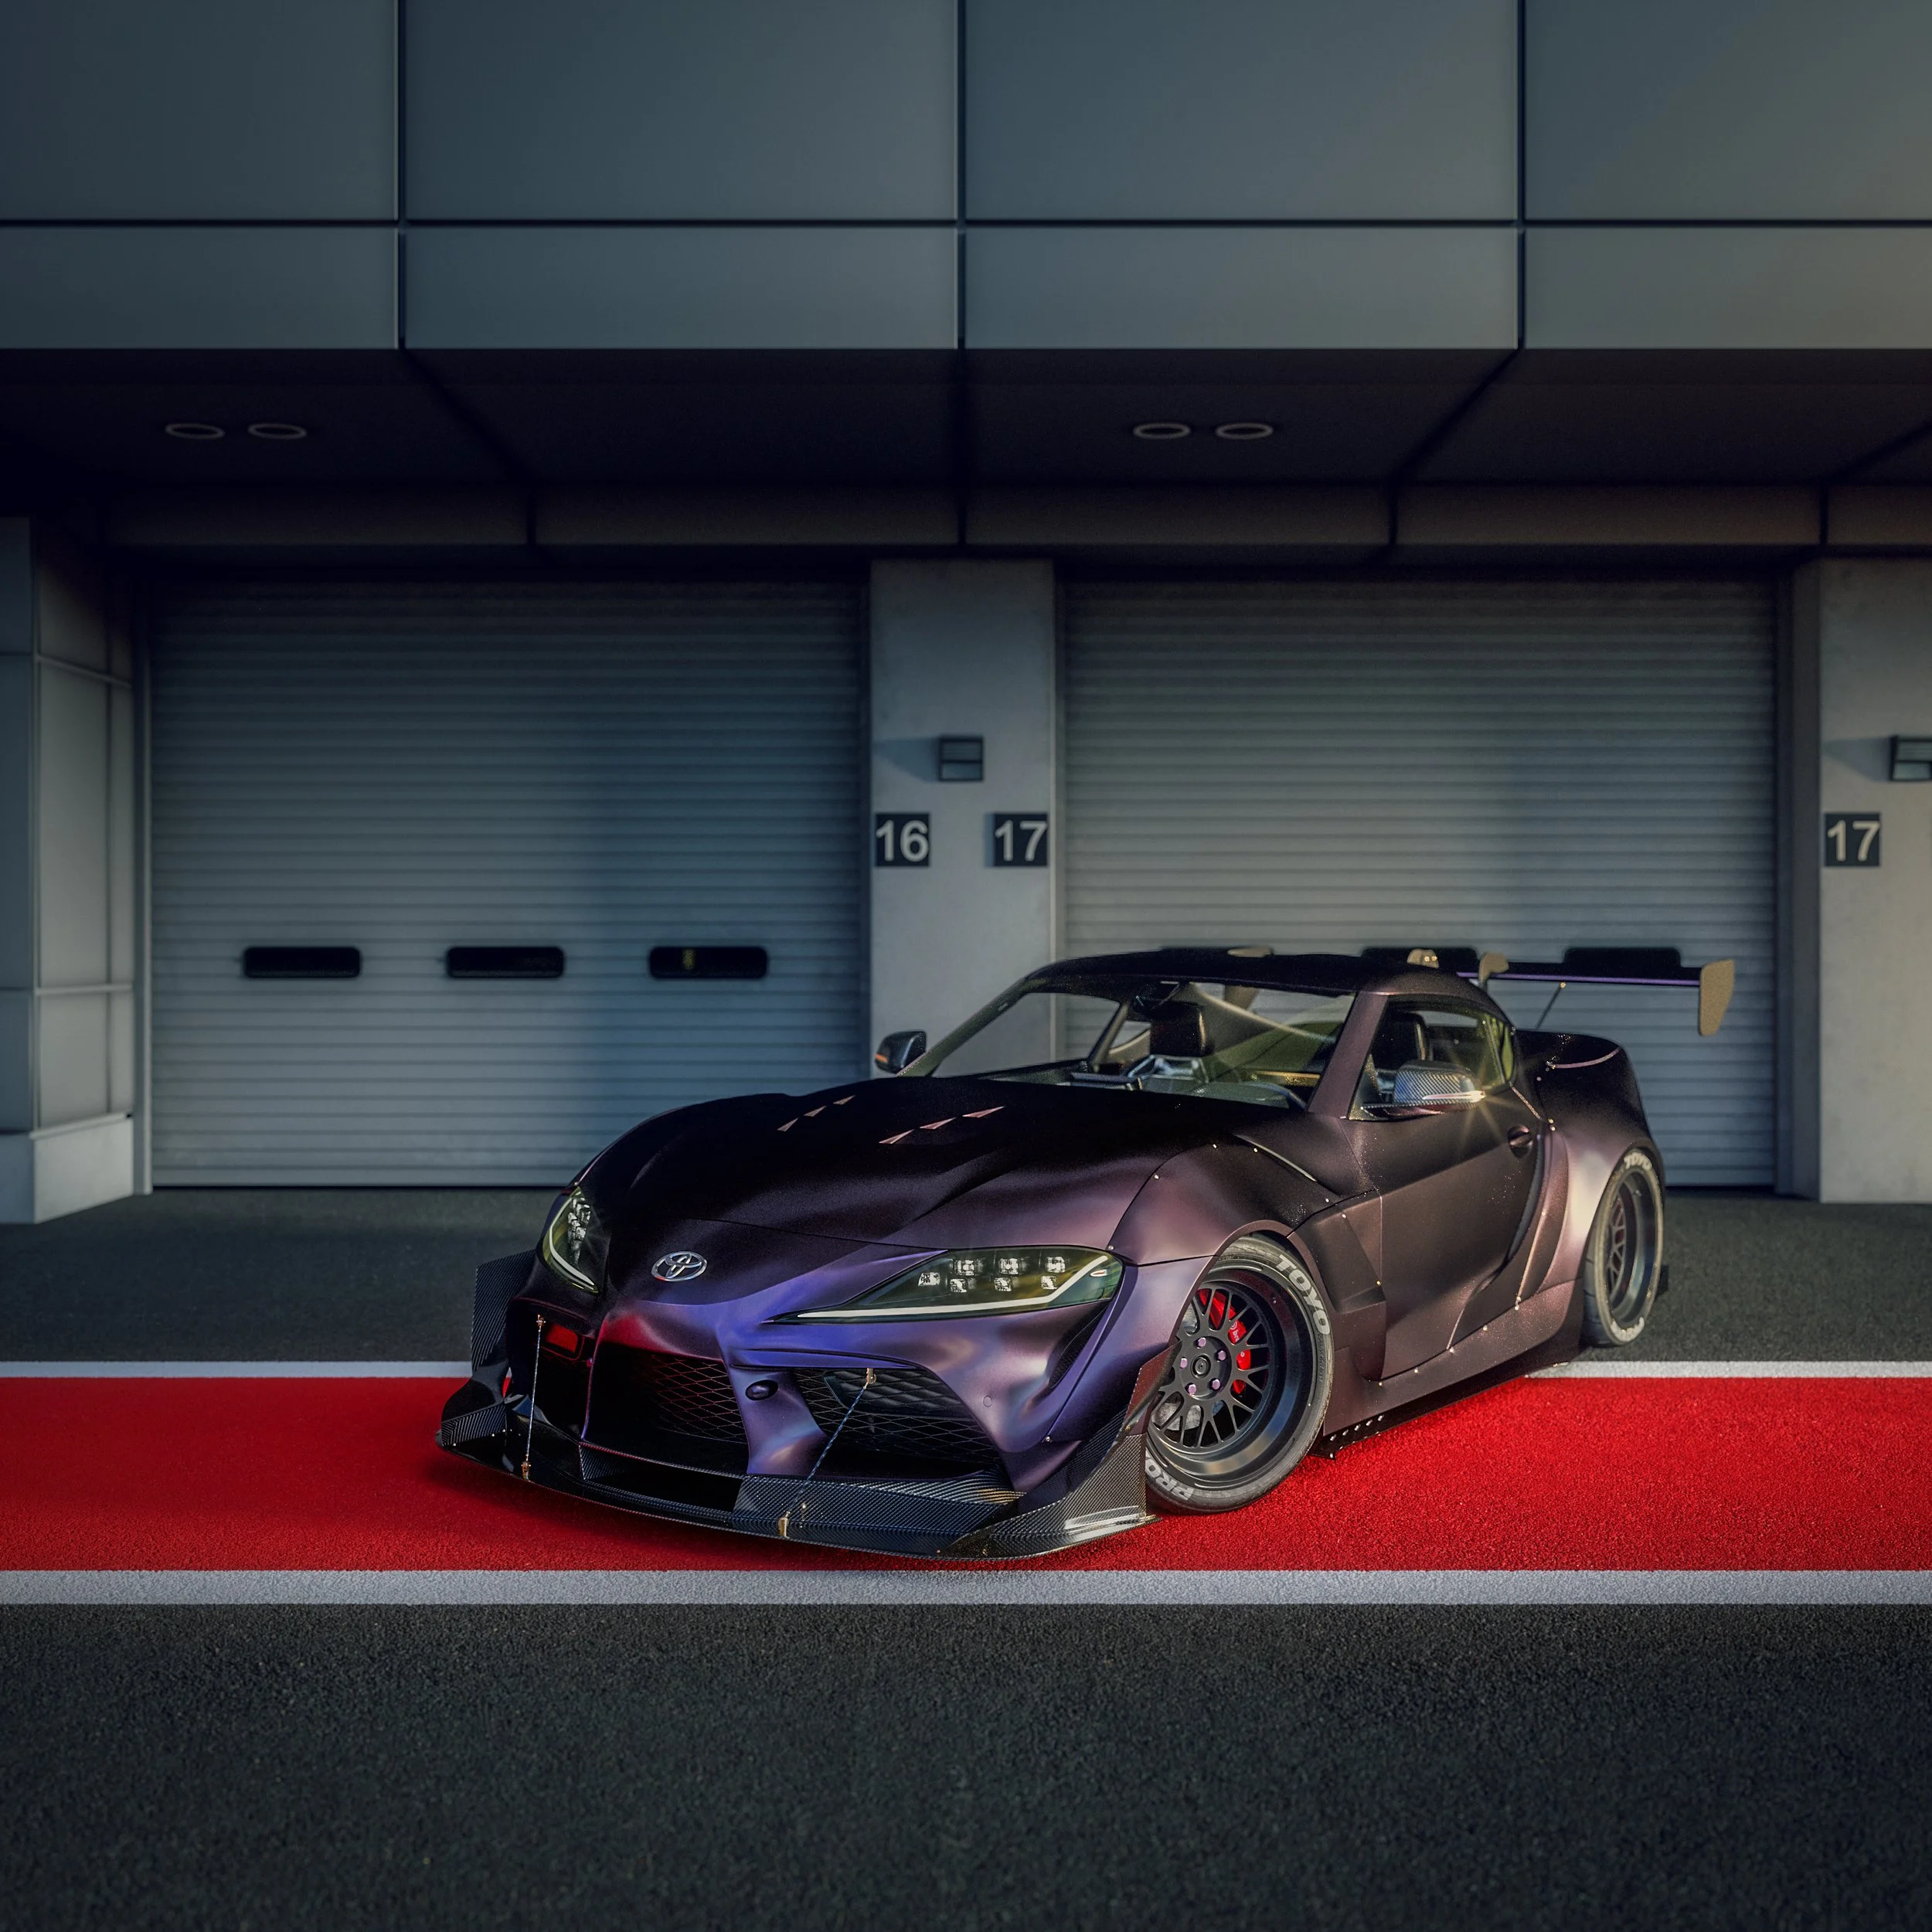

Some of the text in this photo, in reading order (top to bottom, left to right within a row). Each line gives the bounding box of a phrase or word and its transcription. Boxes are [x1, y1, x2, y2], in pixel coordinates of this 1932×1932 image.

[876, 820, 930, 862] 16
[995, 820, 1048, 862] 17
[1828, 820, 1880, 862] 17
[1624, 1152, 1653, 1171] TOYO
[1276, 1254, 1330, 1335] TOYO
[1145, 1447, 1194, 1501] PRO
